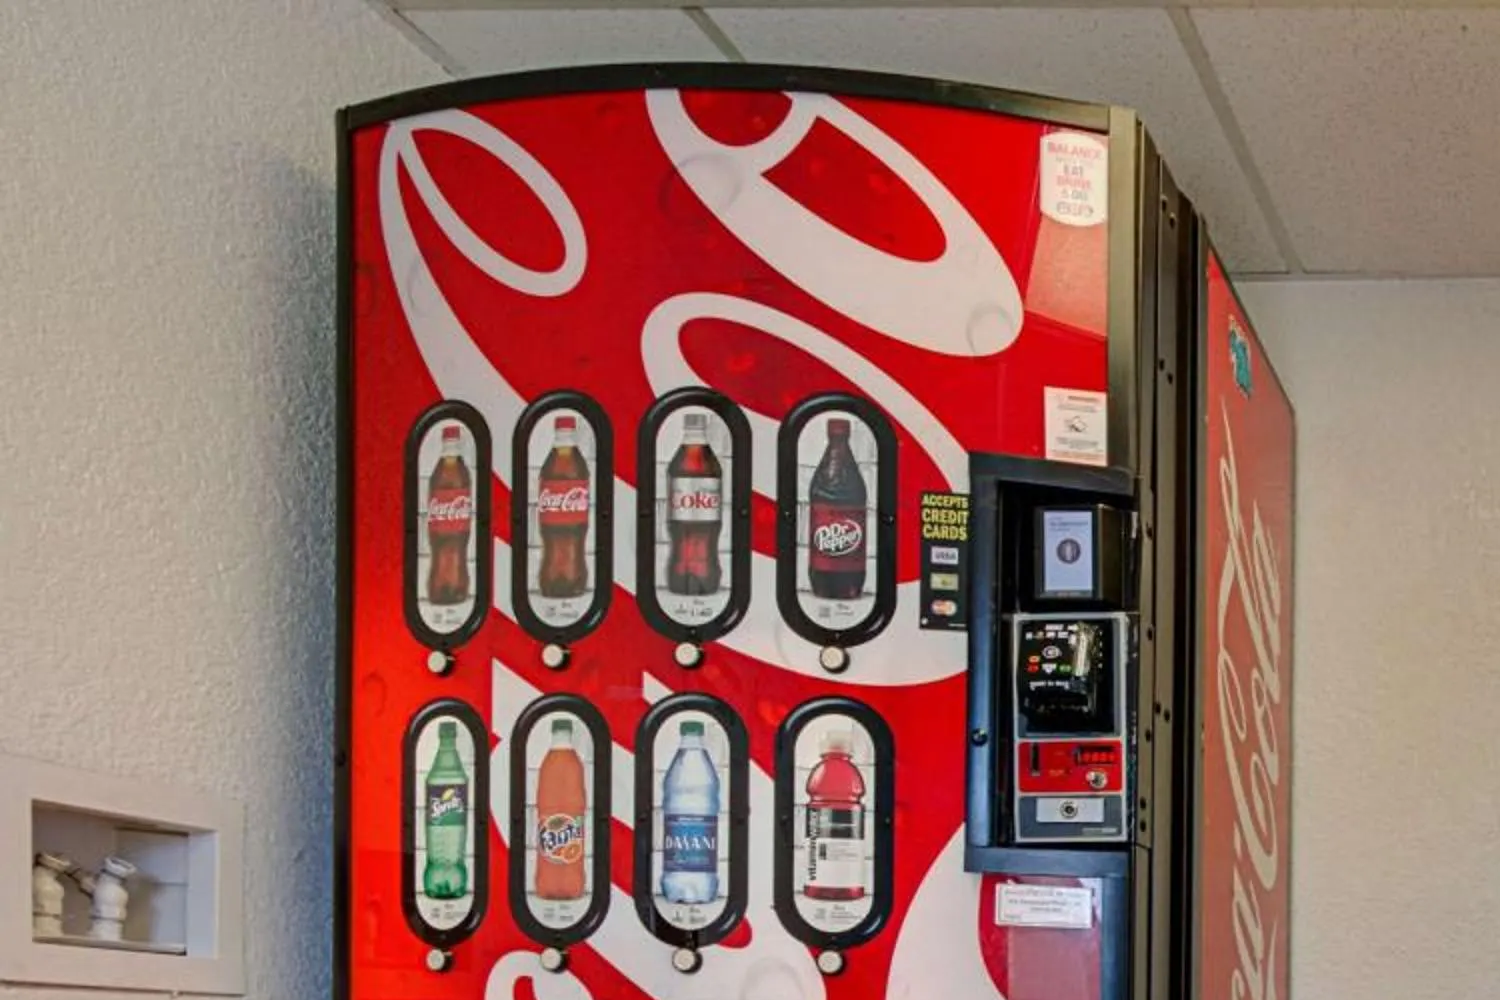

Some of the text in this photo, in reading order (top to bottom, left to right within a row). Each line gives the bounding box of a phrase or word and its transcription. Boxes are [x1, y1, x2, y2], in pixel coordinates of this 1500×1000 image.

[428, 495, 472, 521] Coca-Cola
[538, 487, 588, 513] Coca-Cola
[922, 493, 968, 508] ACCEPTS
[922, 507, 968, 525] CREDIT
[818, 526, 858, 551] Pepper
[830, 522, 848, 536] Dr
[923, 524, 968, 541] CARDS
[540, 823, 583, 850] Fanta
